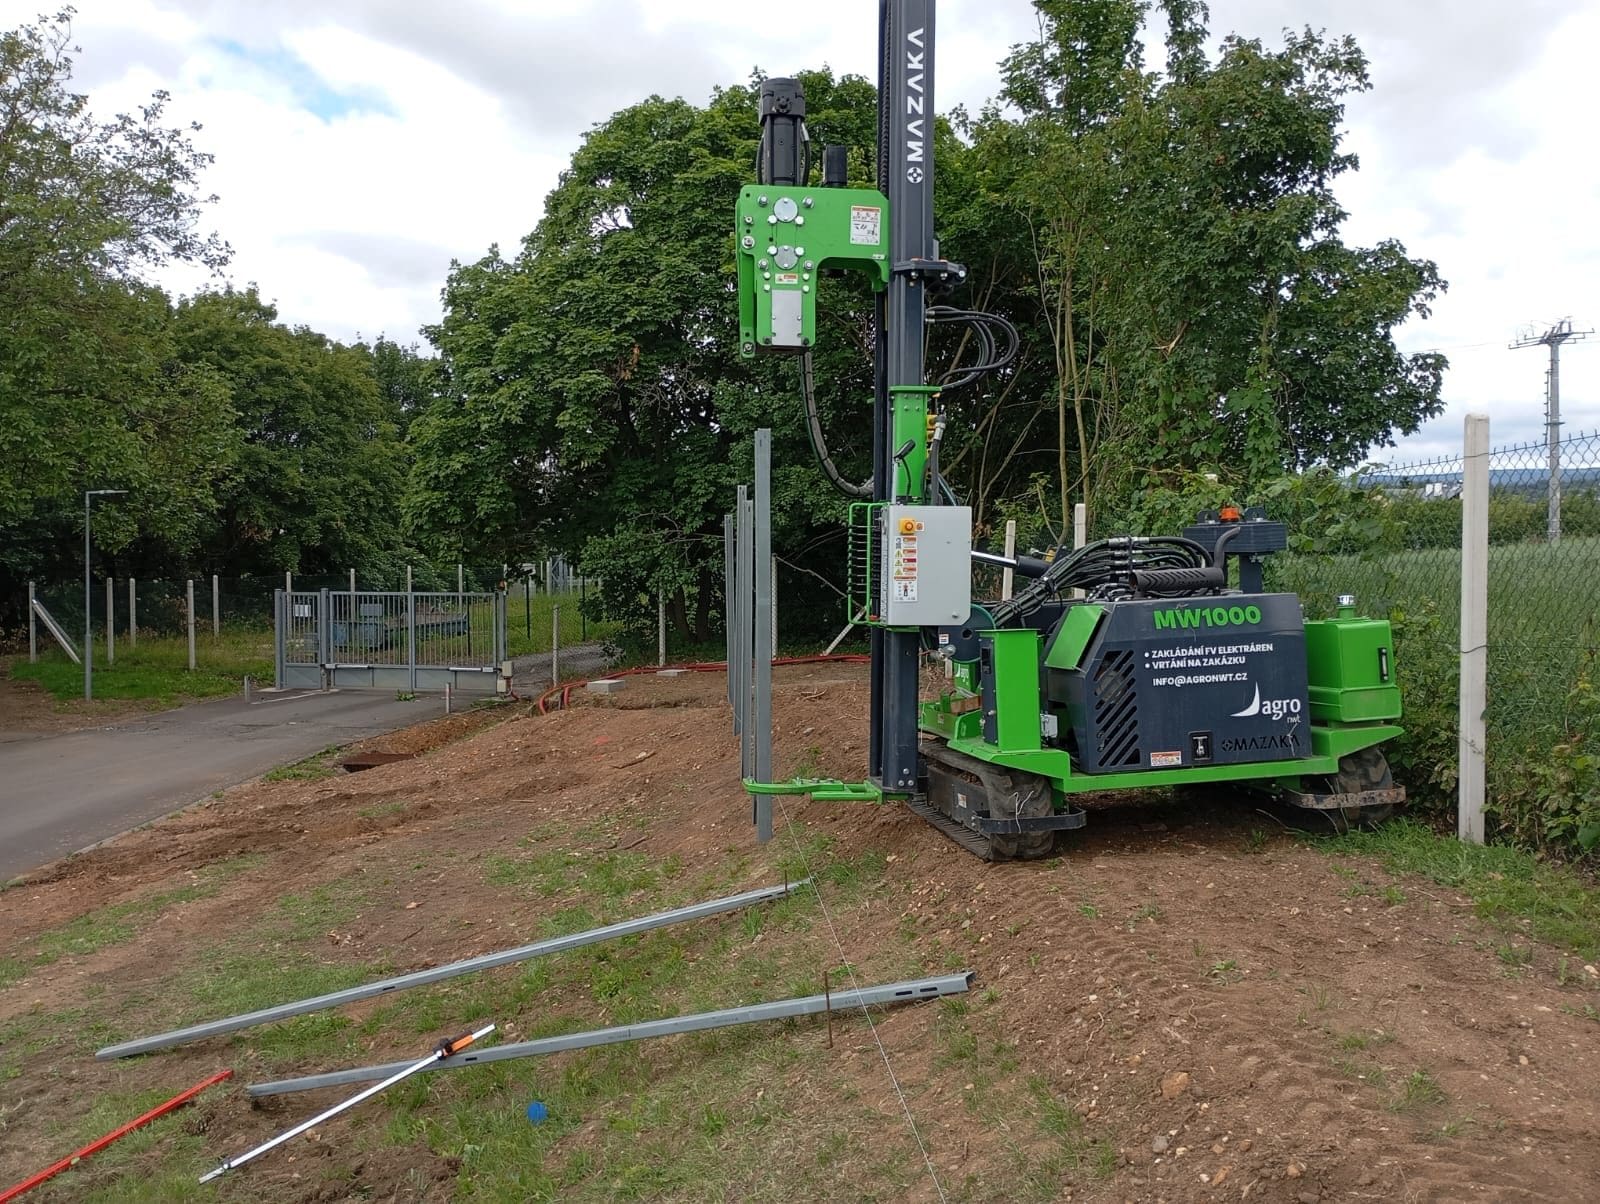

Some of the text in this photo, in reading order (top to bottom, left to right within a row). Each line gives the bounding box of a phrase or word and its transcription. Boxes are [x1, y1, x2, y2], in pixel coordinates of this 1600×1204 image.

[907, 28, 924, 162] MAZAKA
[1153, 605, 1262, 630] MW1000
[1151, 642, 1273, 658] ZAKLÁDÁNÍ FV ELEKTRÁREN
[1152, 655, 1246, 670] VRTÁNÍ NA ZAKÁZKU
[1153, 672, 1248, 687] INFO@AGRONWT.CZ
[1261, 698, 1301, 720] agro
